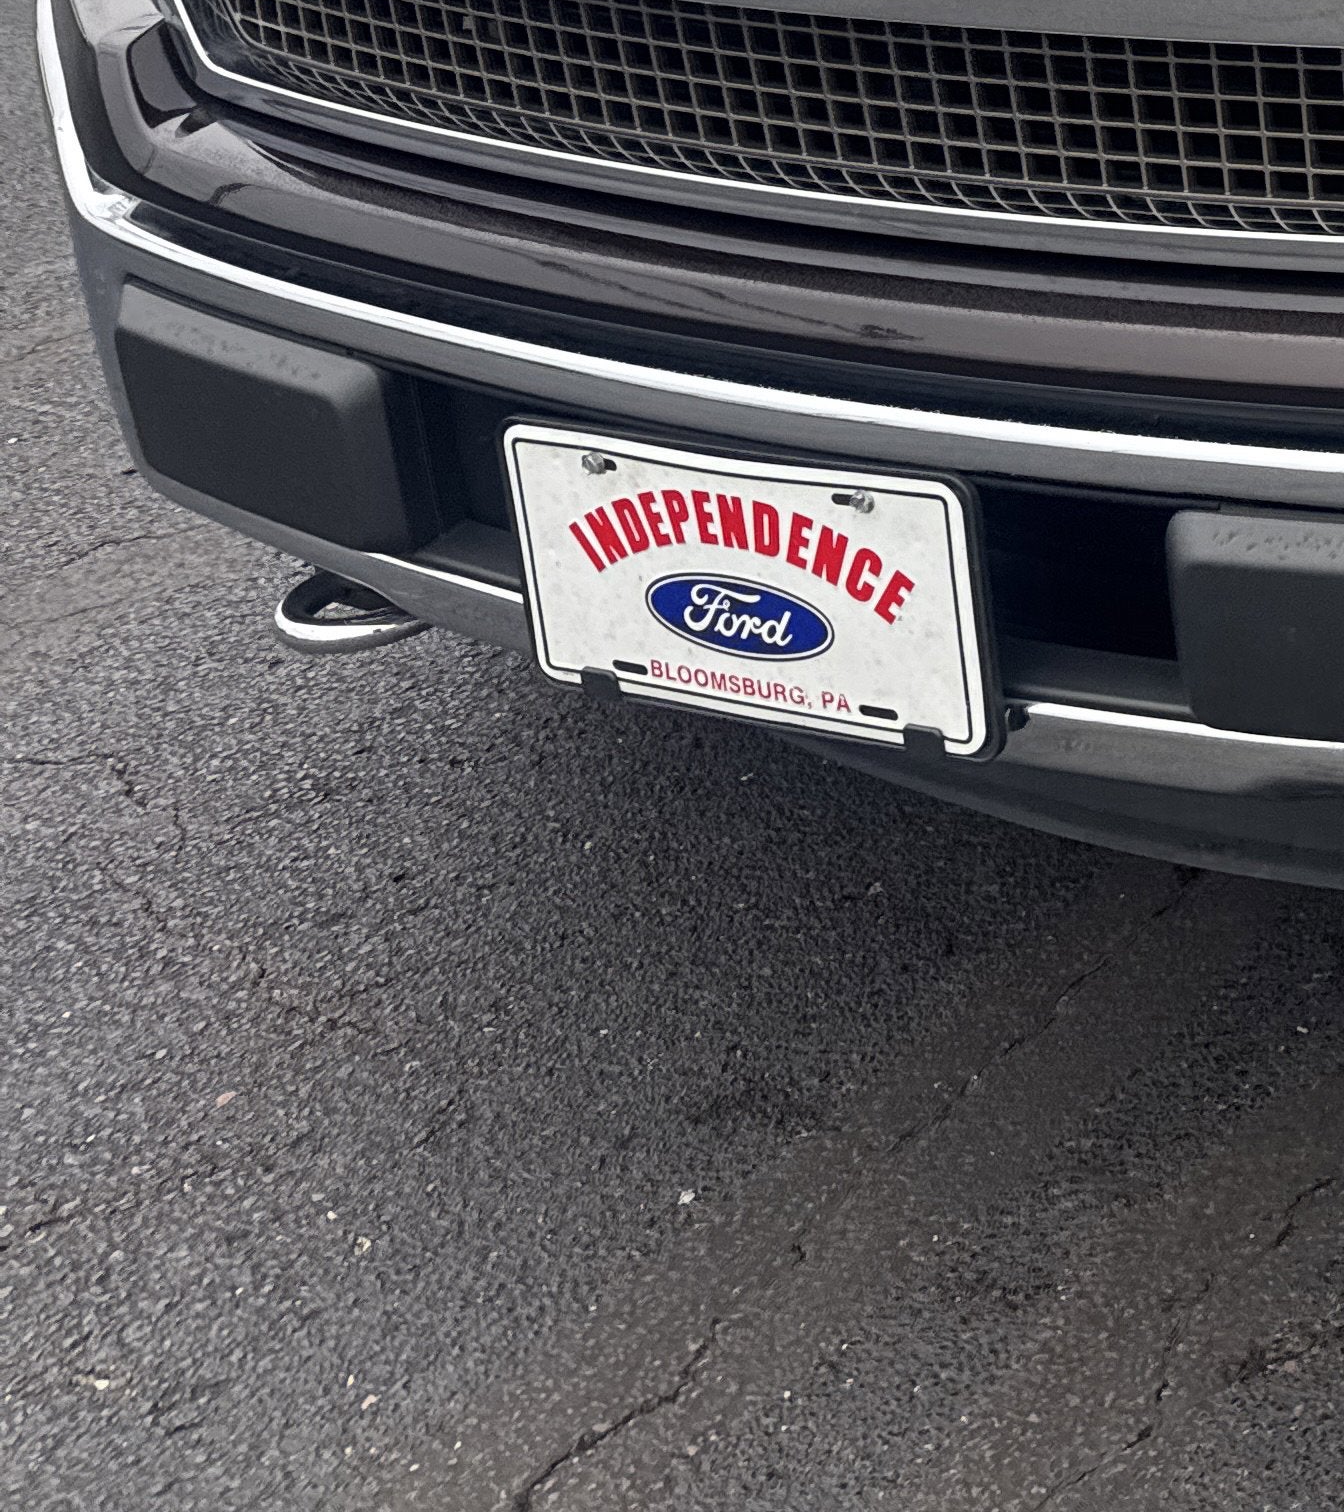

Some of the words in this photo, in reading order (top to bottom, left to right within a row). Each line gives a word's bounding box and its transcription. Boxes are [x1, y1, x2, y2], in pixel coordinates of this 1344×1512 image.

[568, 489, 916, 625] INDEPENDENCE
[683, 583, 793, 648] Ford
[649, 659, 814, 710] BLOOMSBURG,
[821, 692, 852, 714] PA
